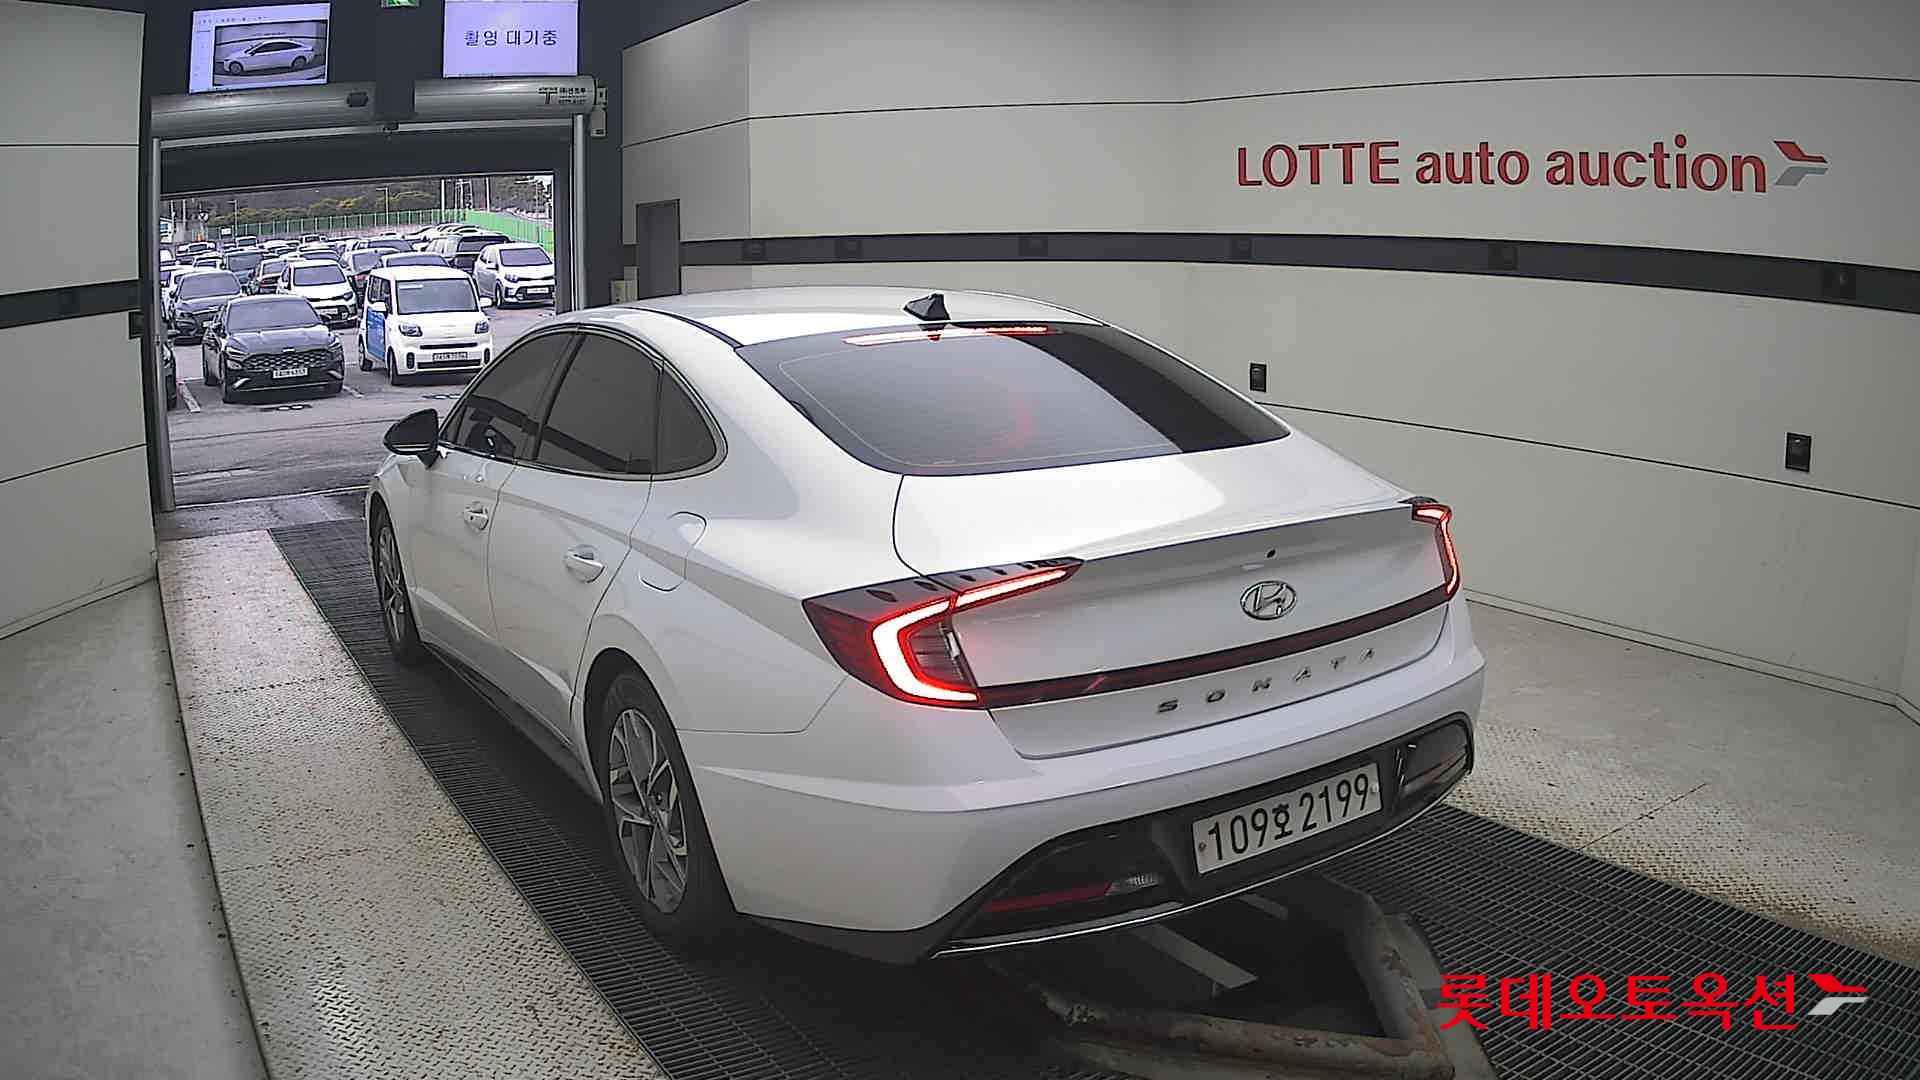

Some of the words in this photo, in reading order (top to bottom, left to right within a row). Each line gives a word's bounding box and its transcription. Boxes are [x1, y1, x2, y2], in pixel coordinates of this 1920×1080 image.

[506, 29, 558, 46] 대기중
[1237, 141, 1398, 187] LOTTE
[1416, 142, 1529, 185] auto
[1545, 135, 1767, 193] auction
[1158, 648, 1376, 713] SONATA
